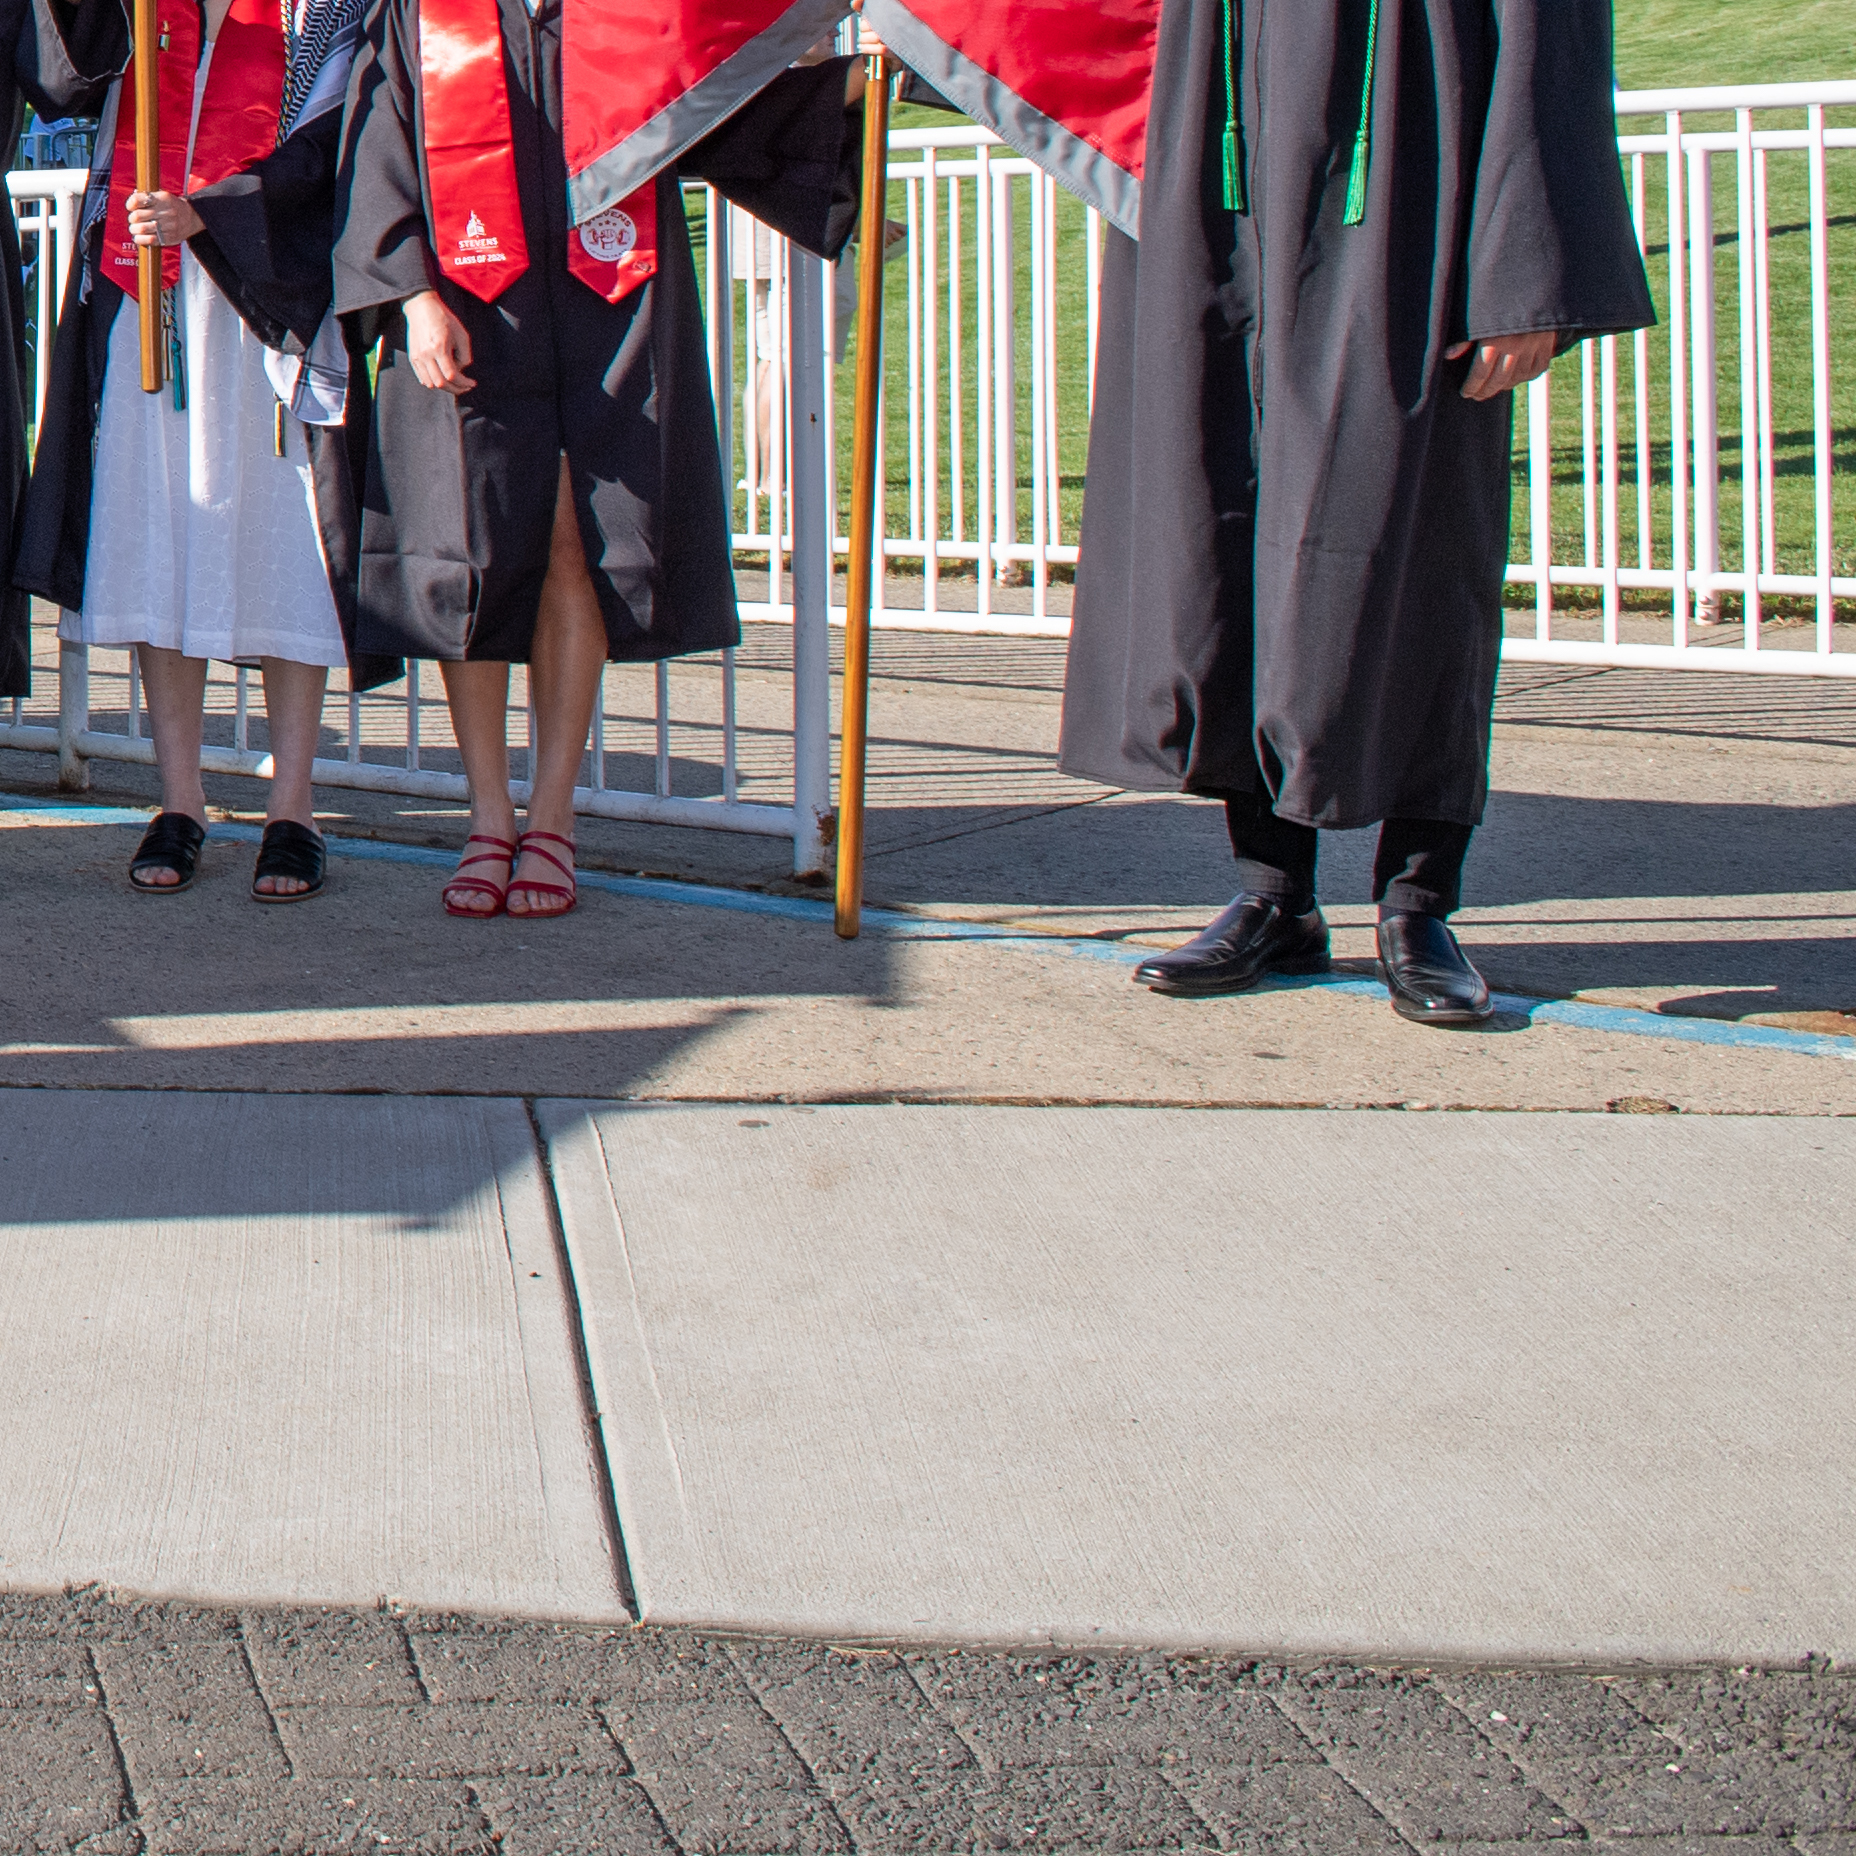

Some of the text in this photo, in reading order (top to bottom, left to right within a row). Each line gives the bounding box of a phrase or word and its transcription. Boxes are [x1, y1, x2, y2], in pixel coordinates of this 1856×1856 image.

[458, 237, 498, 249] STEVENS
[114, 256, 135, 266] CLASS
[454, 256, 476, 265] CLASS
[476, 254, 486, 263] OF
